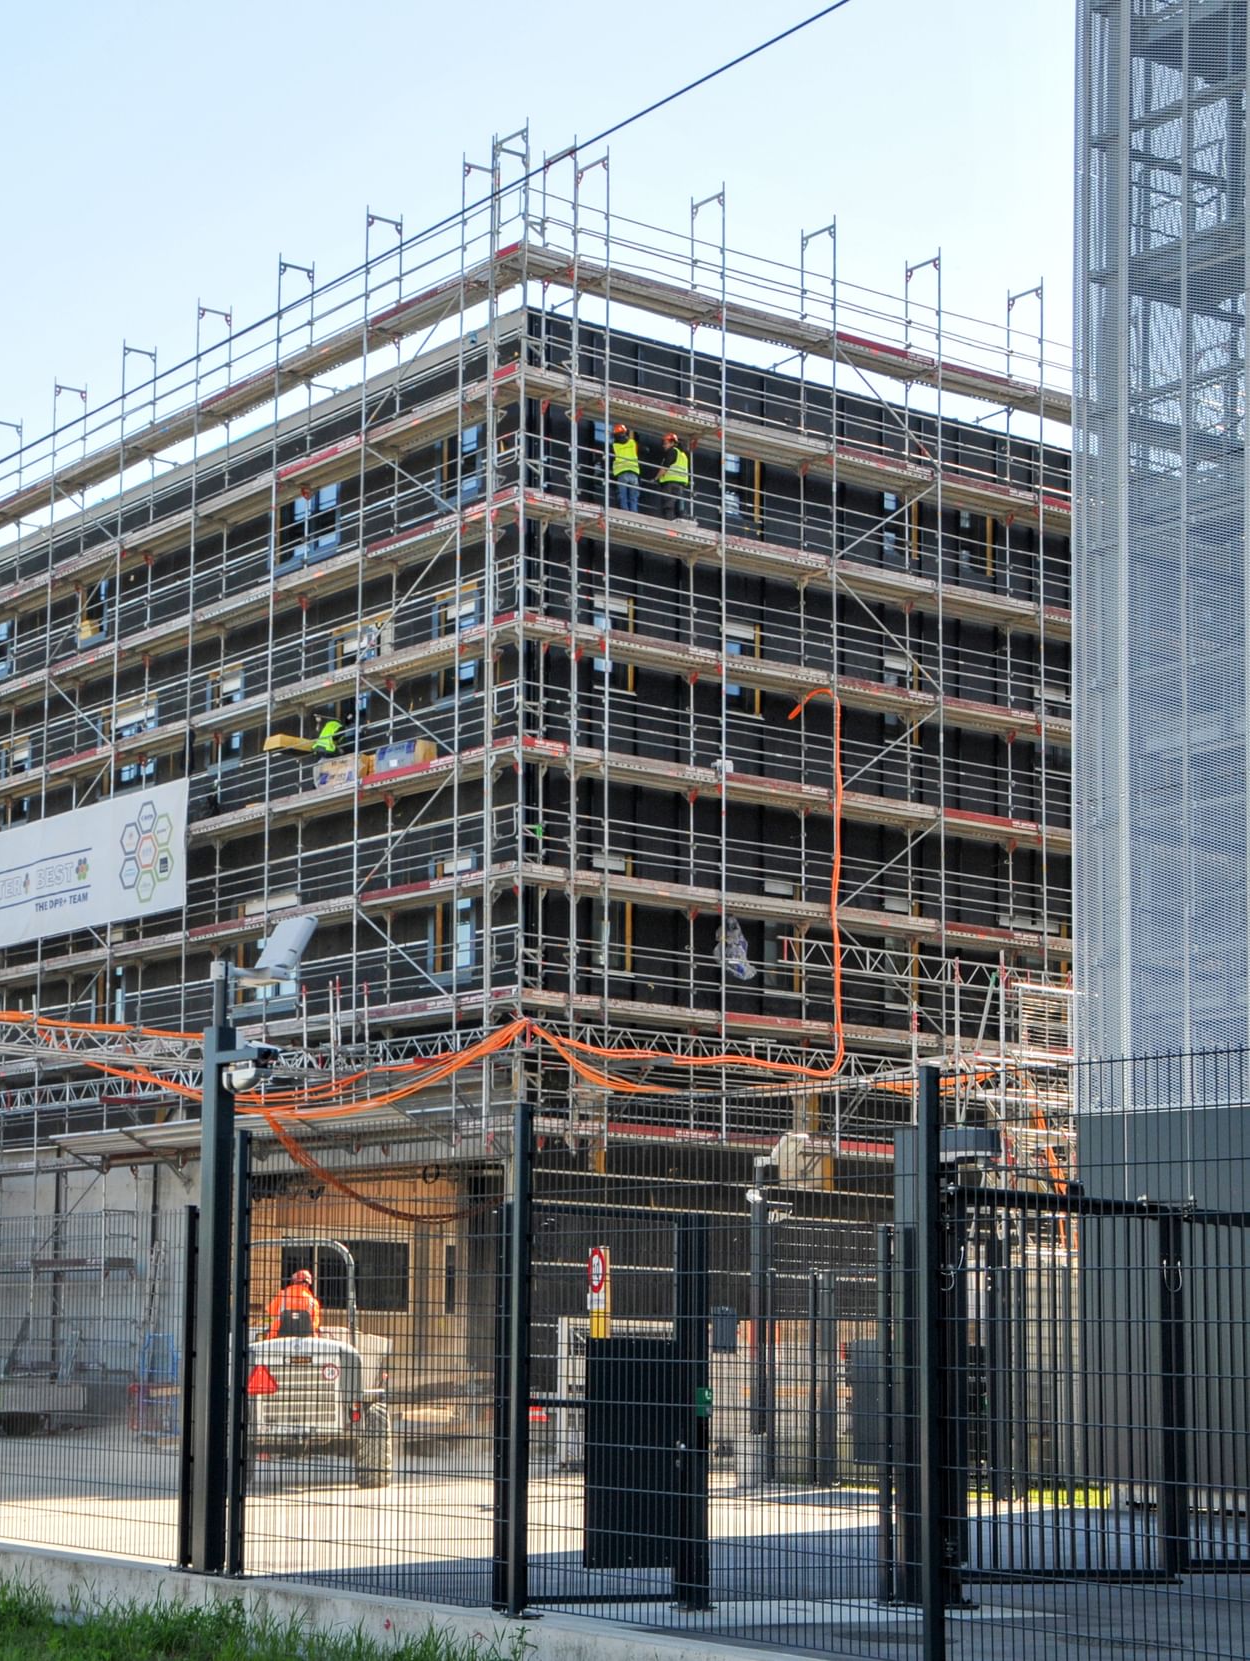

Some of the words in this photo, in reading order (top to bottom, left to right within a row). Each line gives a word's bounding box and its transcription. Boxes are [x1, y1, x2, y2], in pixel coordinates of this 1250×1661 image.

[36, 862, 74, 890] BEST
[35, 901, 48, 912] THE
[69, 892, 88, 904] TEAM
